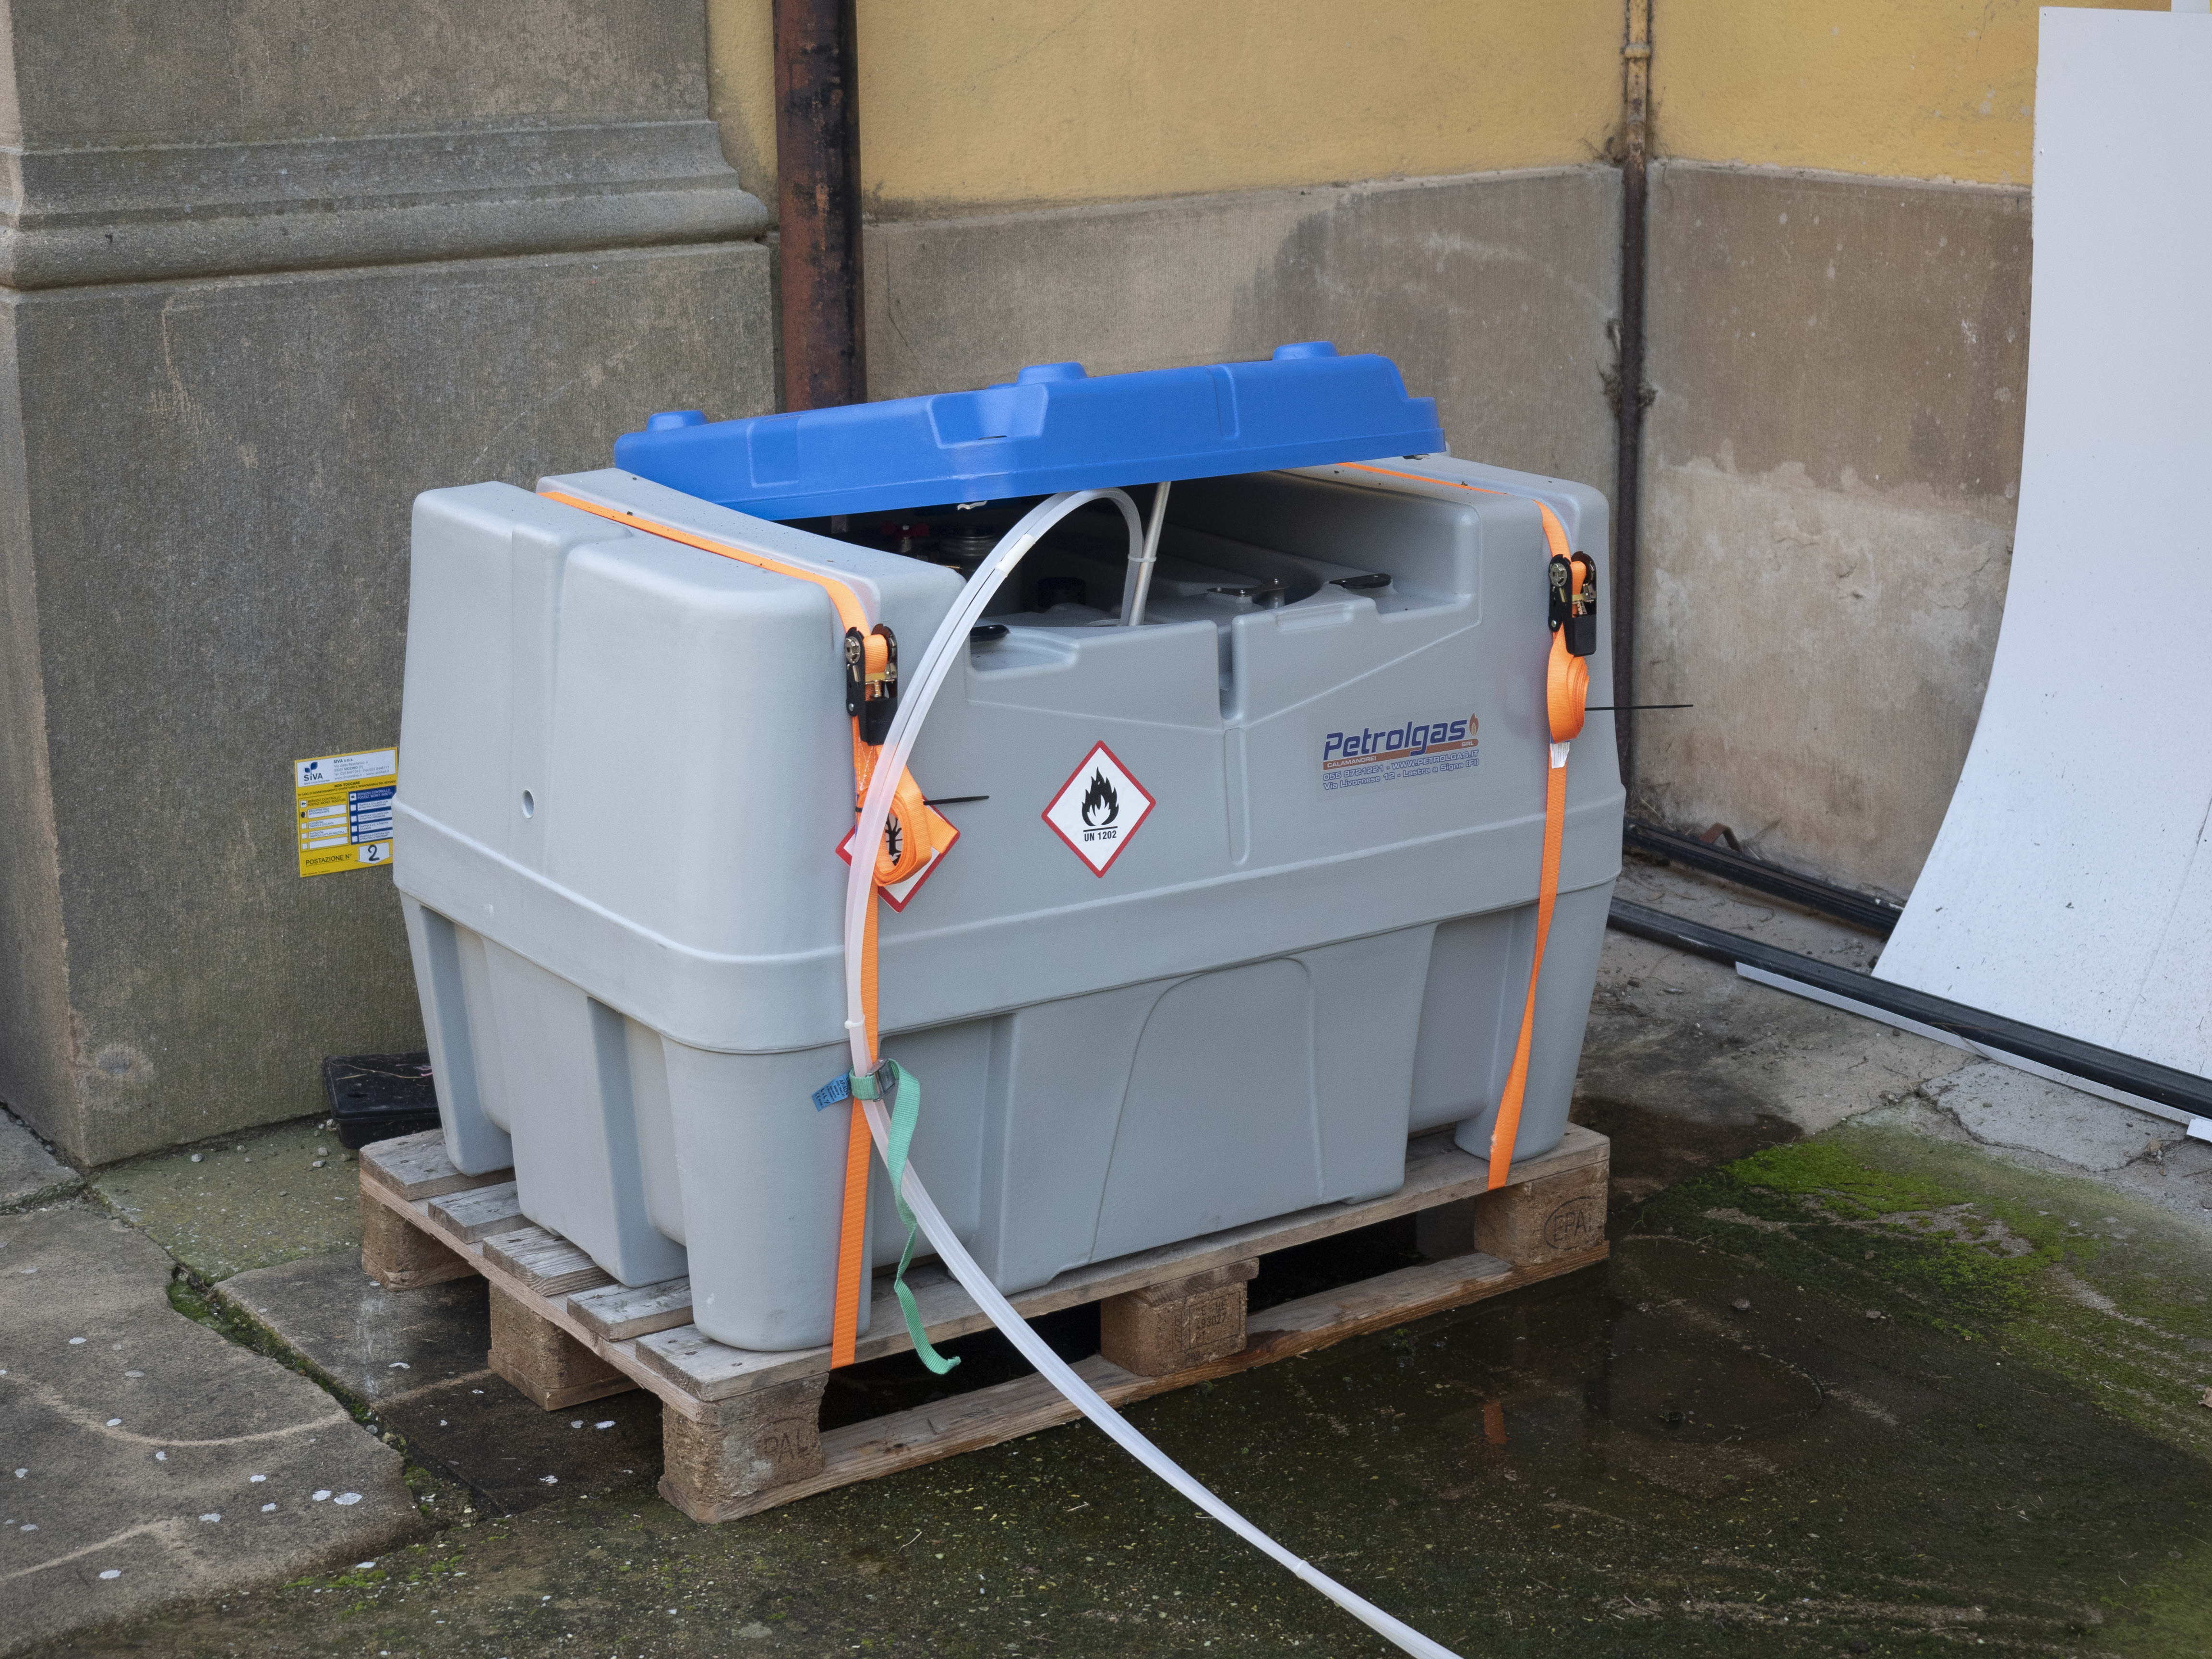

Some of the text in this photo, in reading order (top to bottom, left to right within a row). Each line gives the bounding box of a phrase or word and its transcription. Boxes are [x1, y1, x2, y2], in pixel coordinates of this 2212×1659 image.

[1323, 719, 1468, 761] Petrolgas
[1323, 749, 1479, 781] 055 8721221 WWW.PETROLGAS.IT
[1323, 781, 1338, 791] Via
[1340, 776, 1381, 788] Livornese
[1383, 771, 1395, 780] 12
[1403, 767, 1431, 777] Lastra
[1440, 762, 1464, 771] Signa
[1466, 758, 1479, 768] (FI)
[1327, 756, 1376, 768] CALAMANDREI
[1084, 830, 1117, 842] UN 1202
[305, 854, 344, 865] POSTAZIONE
[368, 844, 380, 861] 2
